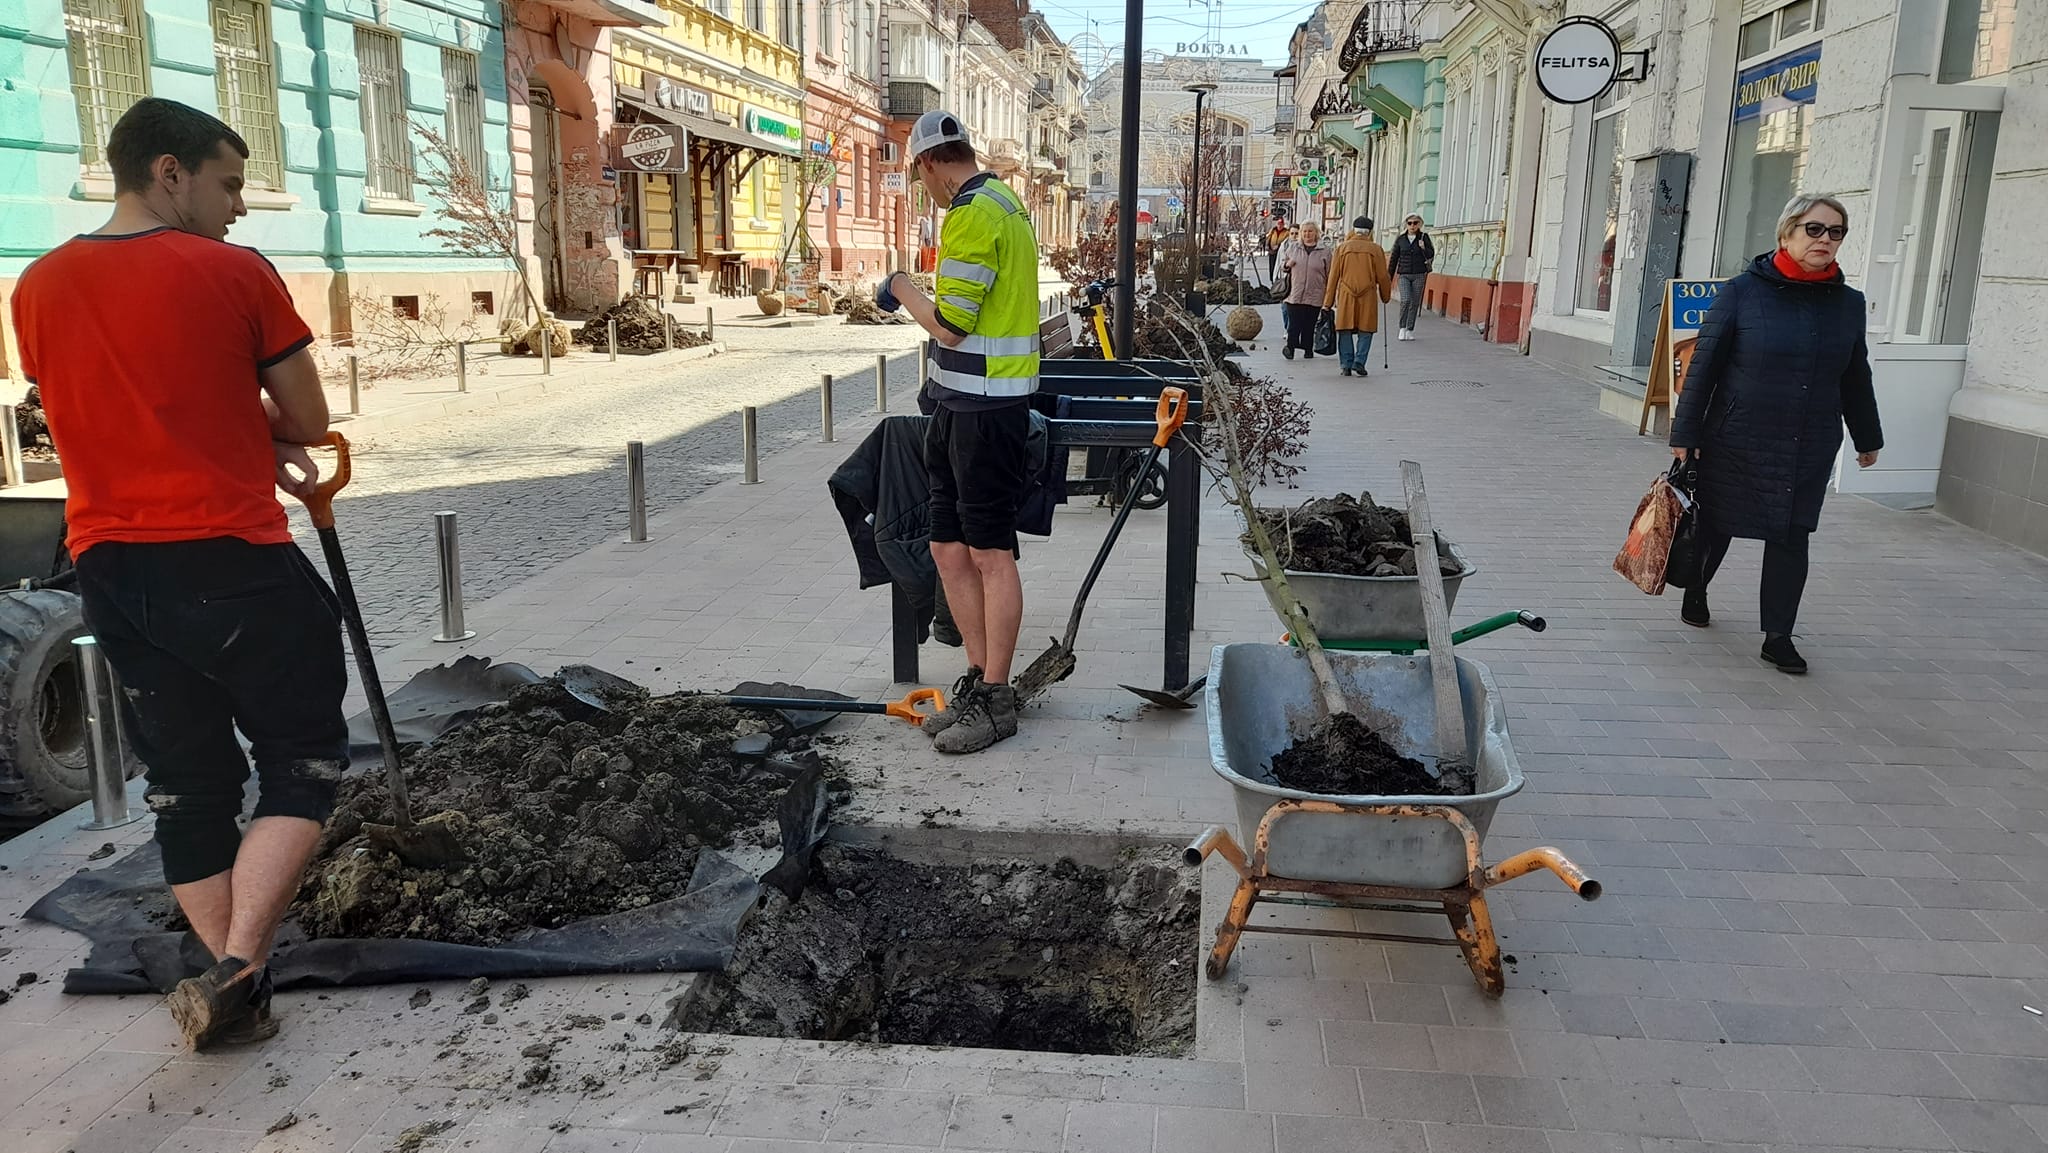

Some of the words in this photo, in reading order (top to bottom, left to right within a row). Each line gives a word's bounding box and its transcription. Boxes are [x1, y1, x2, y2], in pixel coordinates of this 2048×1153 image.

[1176, 42, 1249, 55] ВОКЗАЛ
[1541, 56, 1610, 69] FELITSA
[1738, 72, 1781, 108] ЗОЛОТІ
[671, 85, 685, 107] LA
[686, 88, 709, 114] PIZZA
[634, 142, 643, 151] LA
[645, 138, 661, 148] PIZZA
